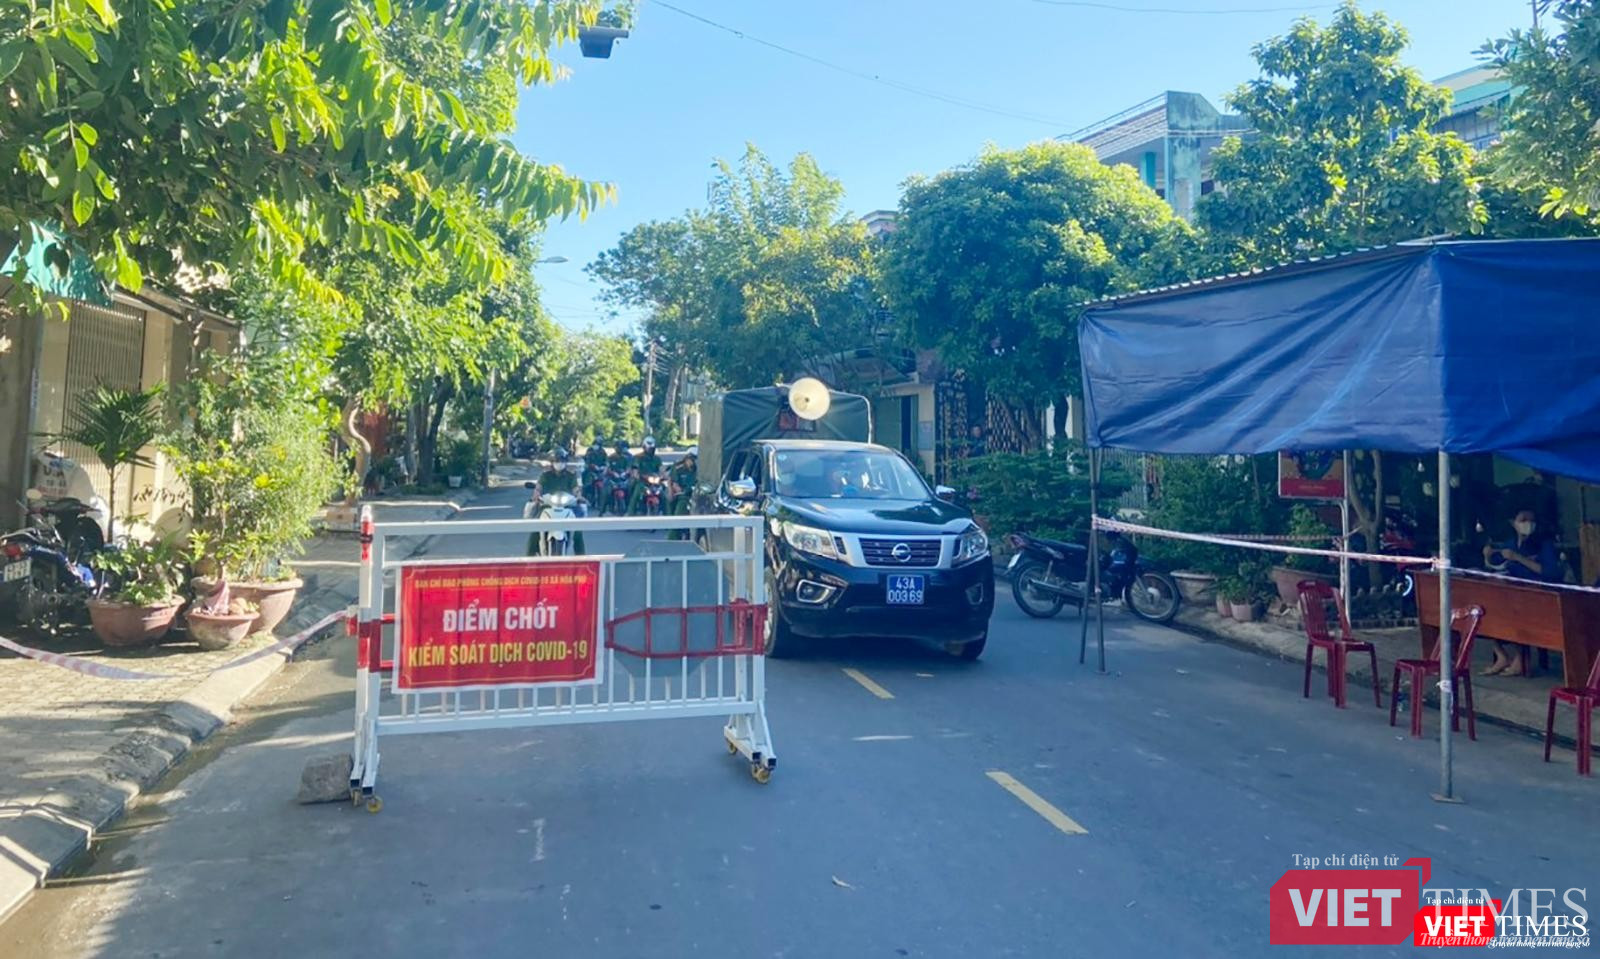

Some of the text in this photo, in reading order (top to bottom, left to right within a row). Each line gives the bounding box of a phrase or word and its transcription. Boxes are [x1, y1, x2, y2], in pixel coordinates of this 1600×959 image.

[896, 577, 915, 589] 43A
[443, 598, 559, 632] ĐIỂM CHỐT
[408, 638, 588, 667] KIỂM SOÁT DỊCH COVID-19
